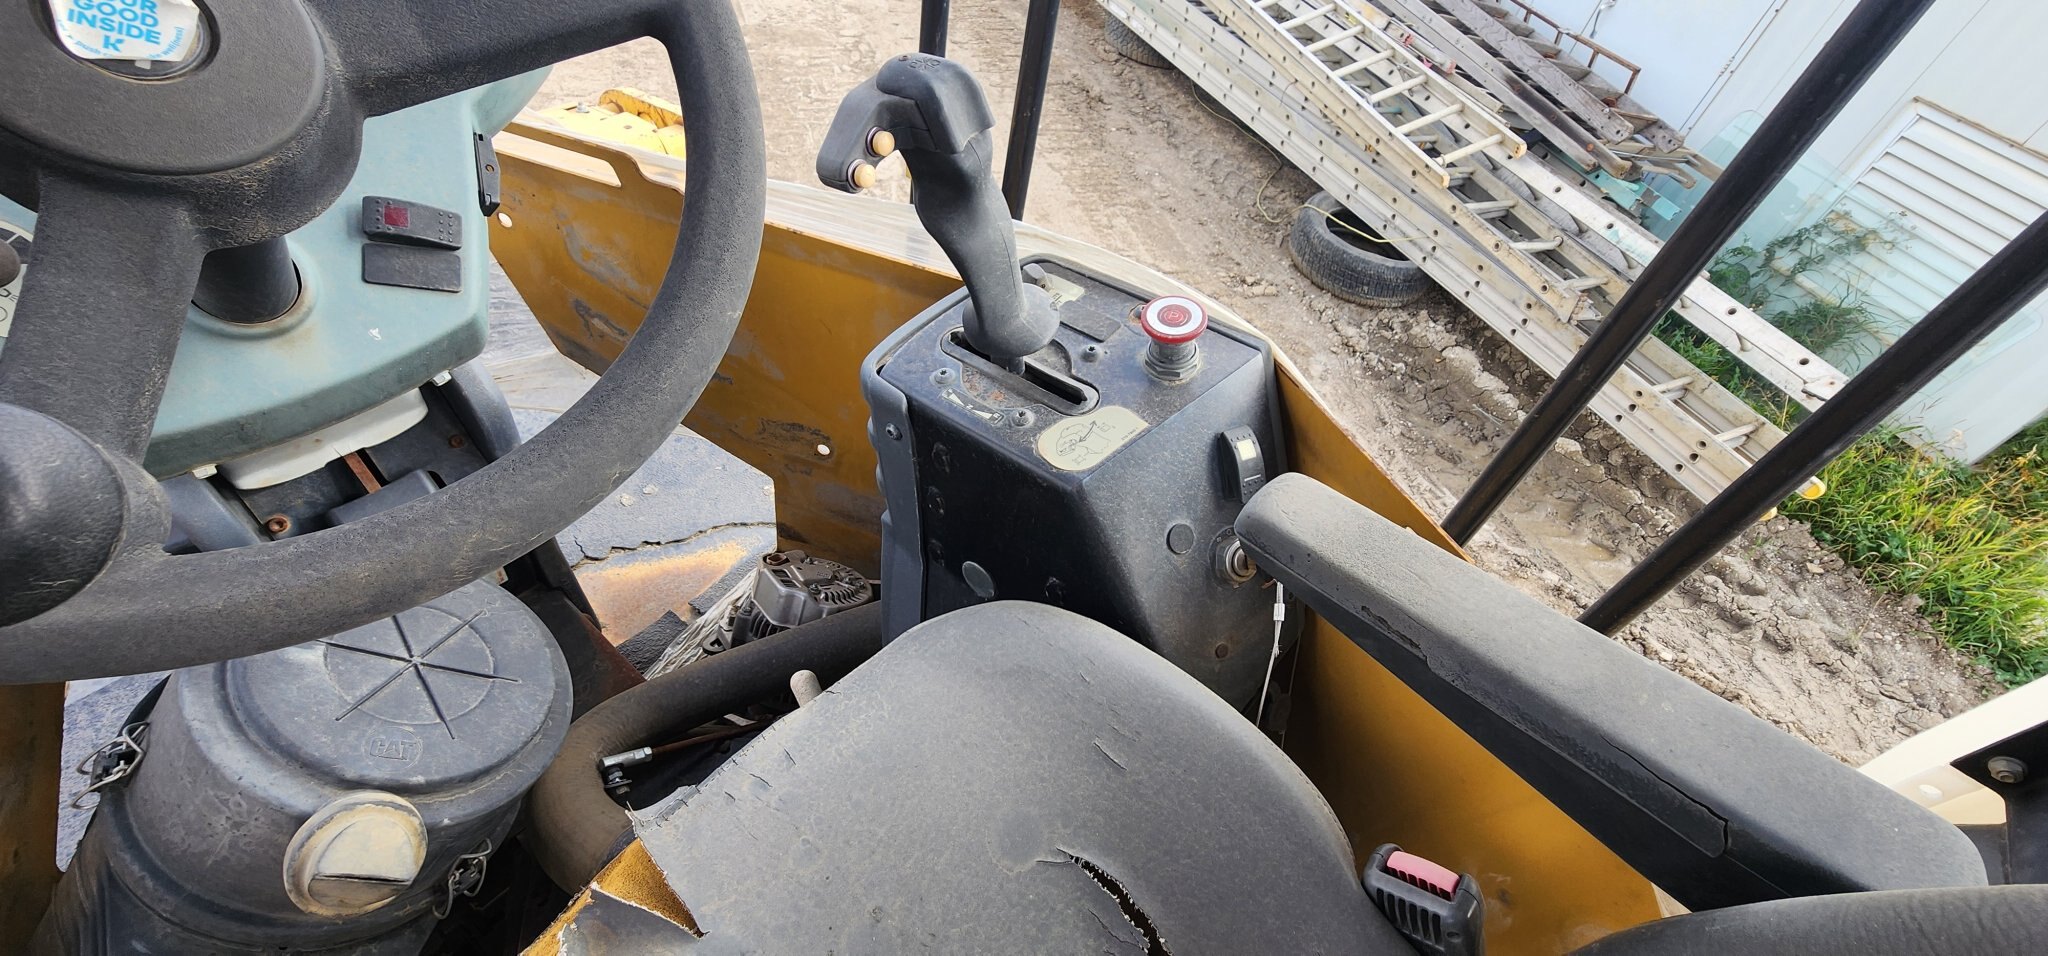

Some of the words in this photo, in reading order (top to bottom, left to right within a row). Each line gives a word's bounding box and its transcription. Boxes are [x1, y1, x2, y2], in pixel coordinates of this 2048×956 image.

[67, 8, 161, 45] INSIDE
[73, 0, 159, 27] GOOD
[369, 736, 417, 761] CAT
